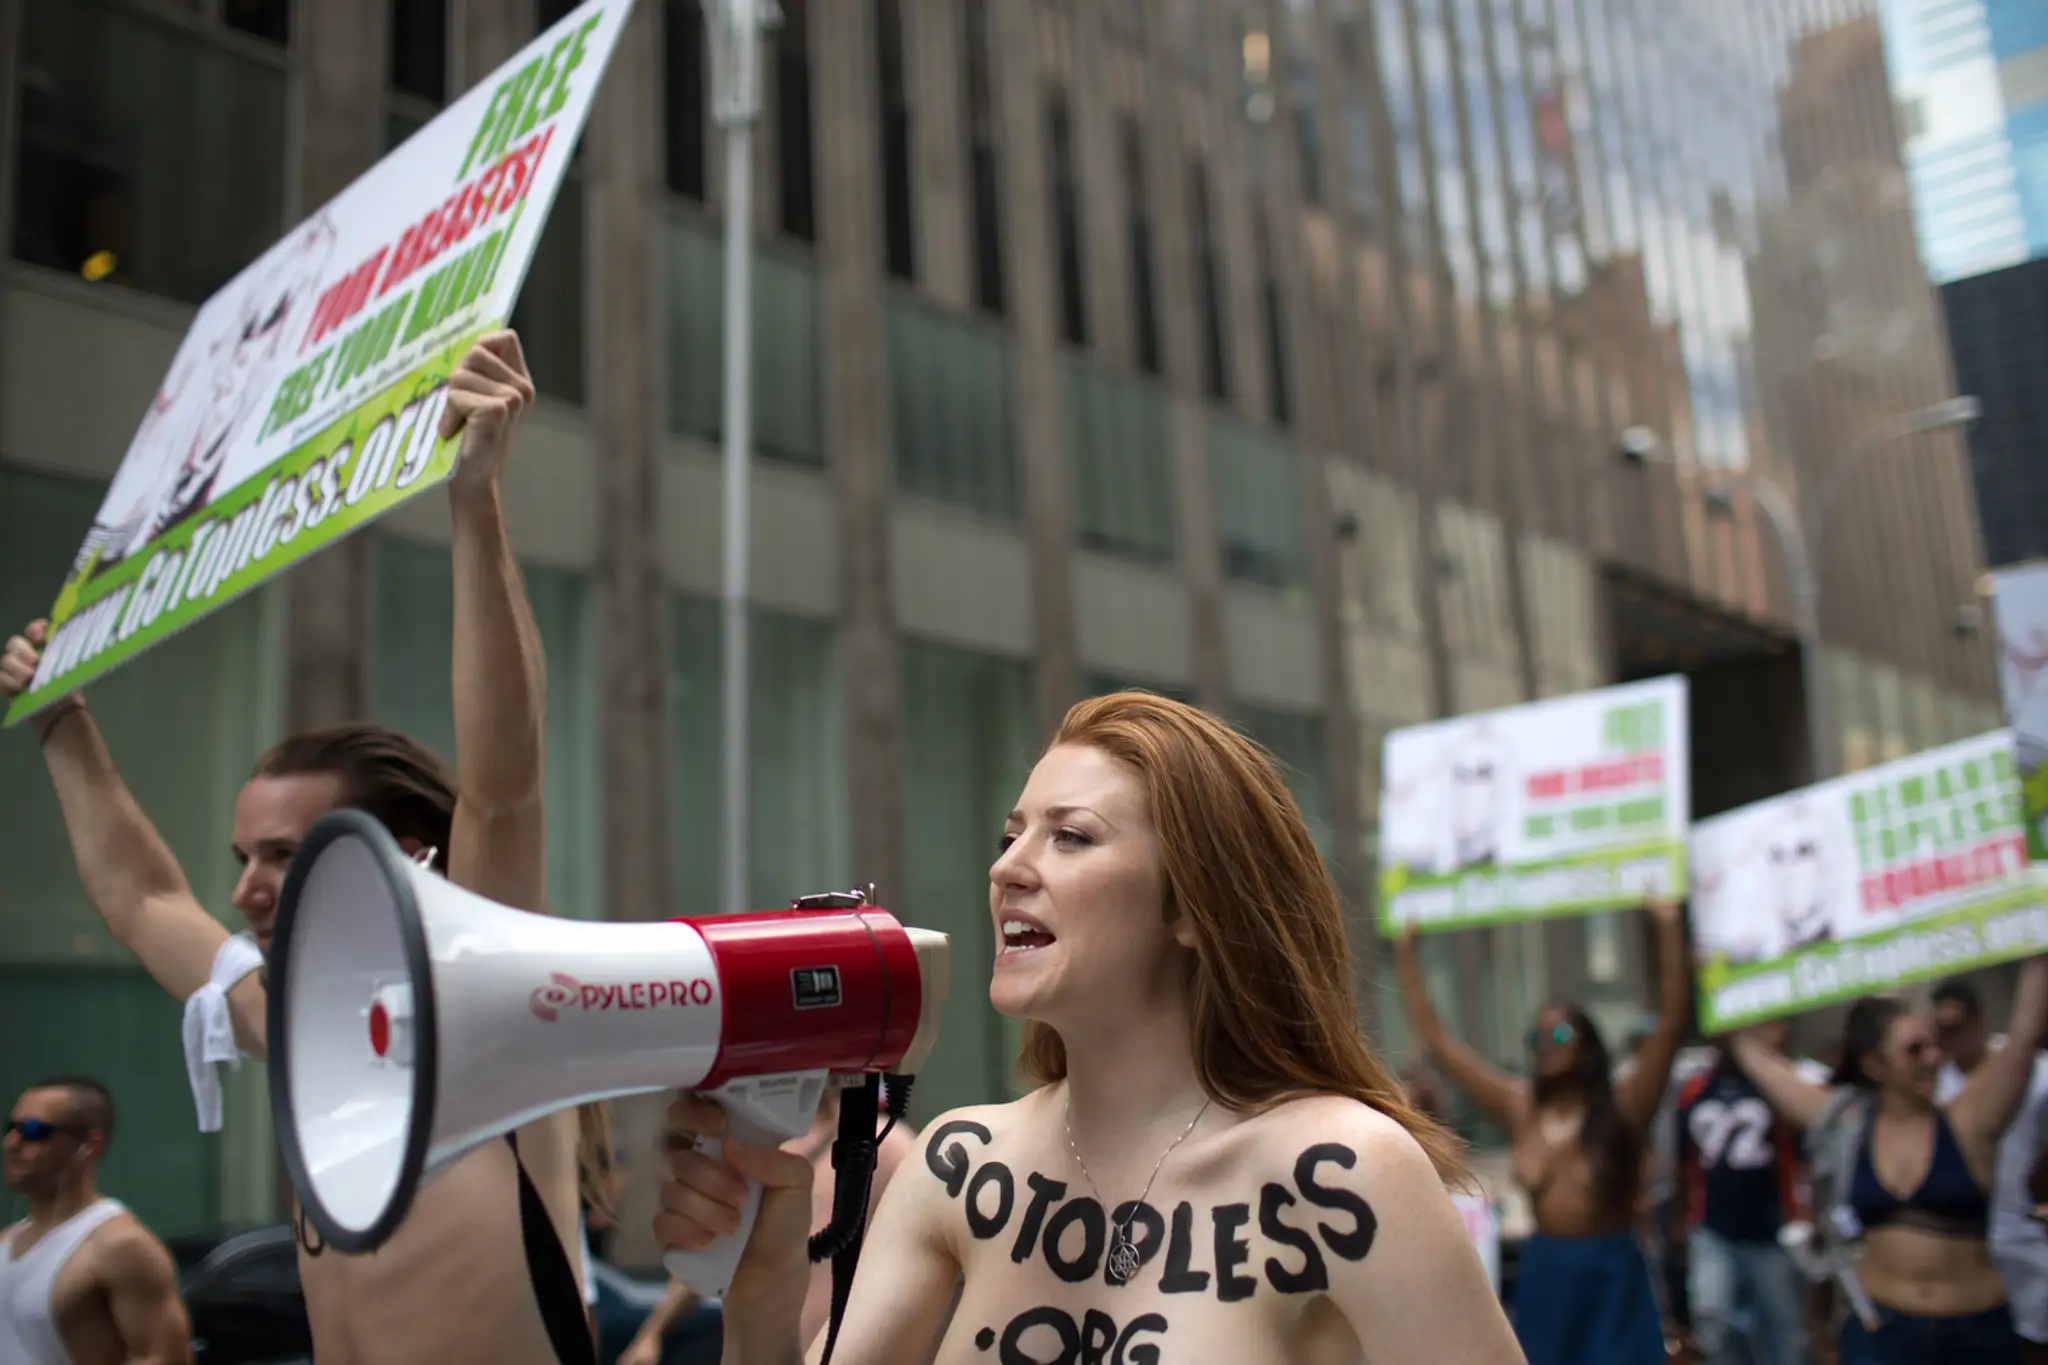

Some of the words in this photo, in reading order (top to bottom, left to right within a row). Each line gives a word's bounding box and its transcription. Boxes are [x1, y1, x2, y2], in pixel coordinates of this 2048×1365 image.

[455, 9, 602, 183] FREE
[256, 345, 335, 447] FREE
[321, 289, 414, 402] YOUR
[397, 198, 526, 351] MIND!
[298, 243, 391, 357] YOUR
[376, 123, 556, 300] BREASTS!
[29, 383, 449, 693] www.GoTopless.org
[1860, 832, 2029, 914] EQUALITY
[581, 978, 713, 1011] PYLEPRO
[1689, 1098, 1774, 1170] 92
